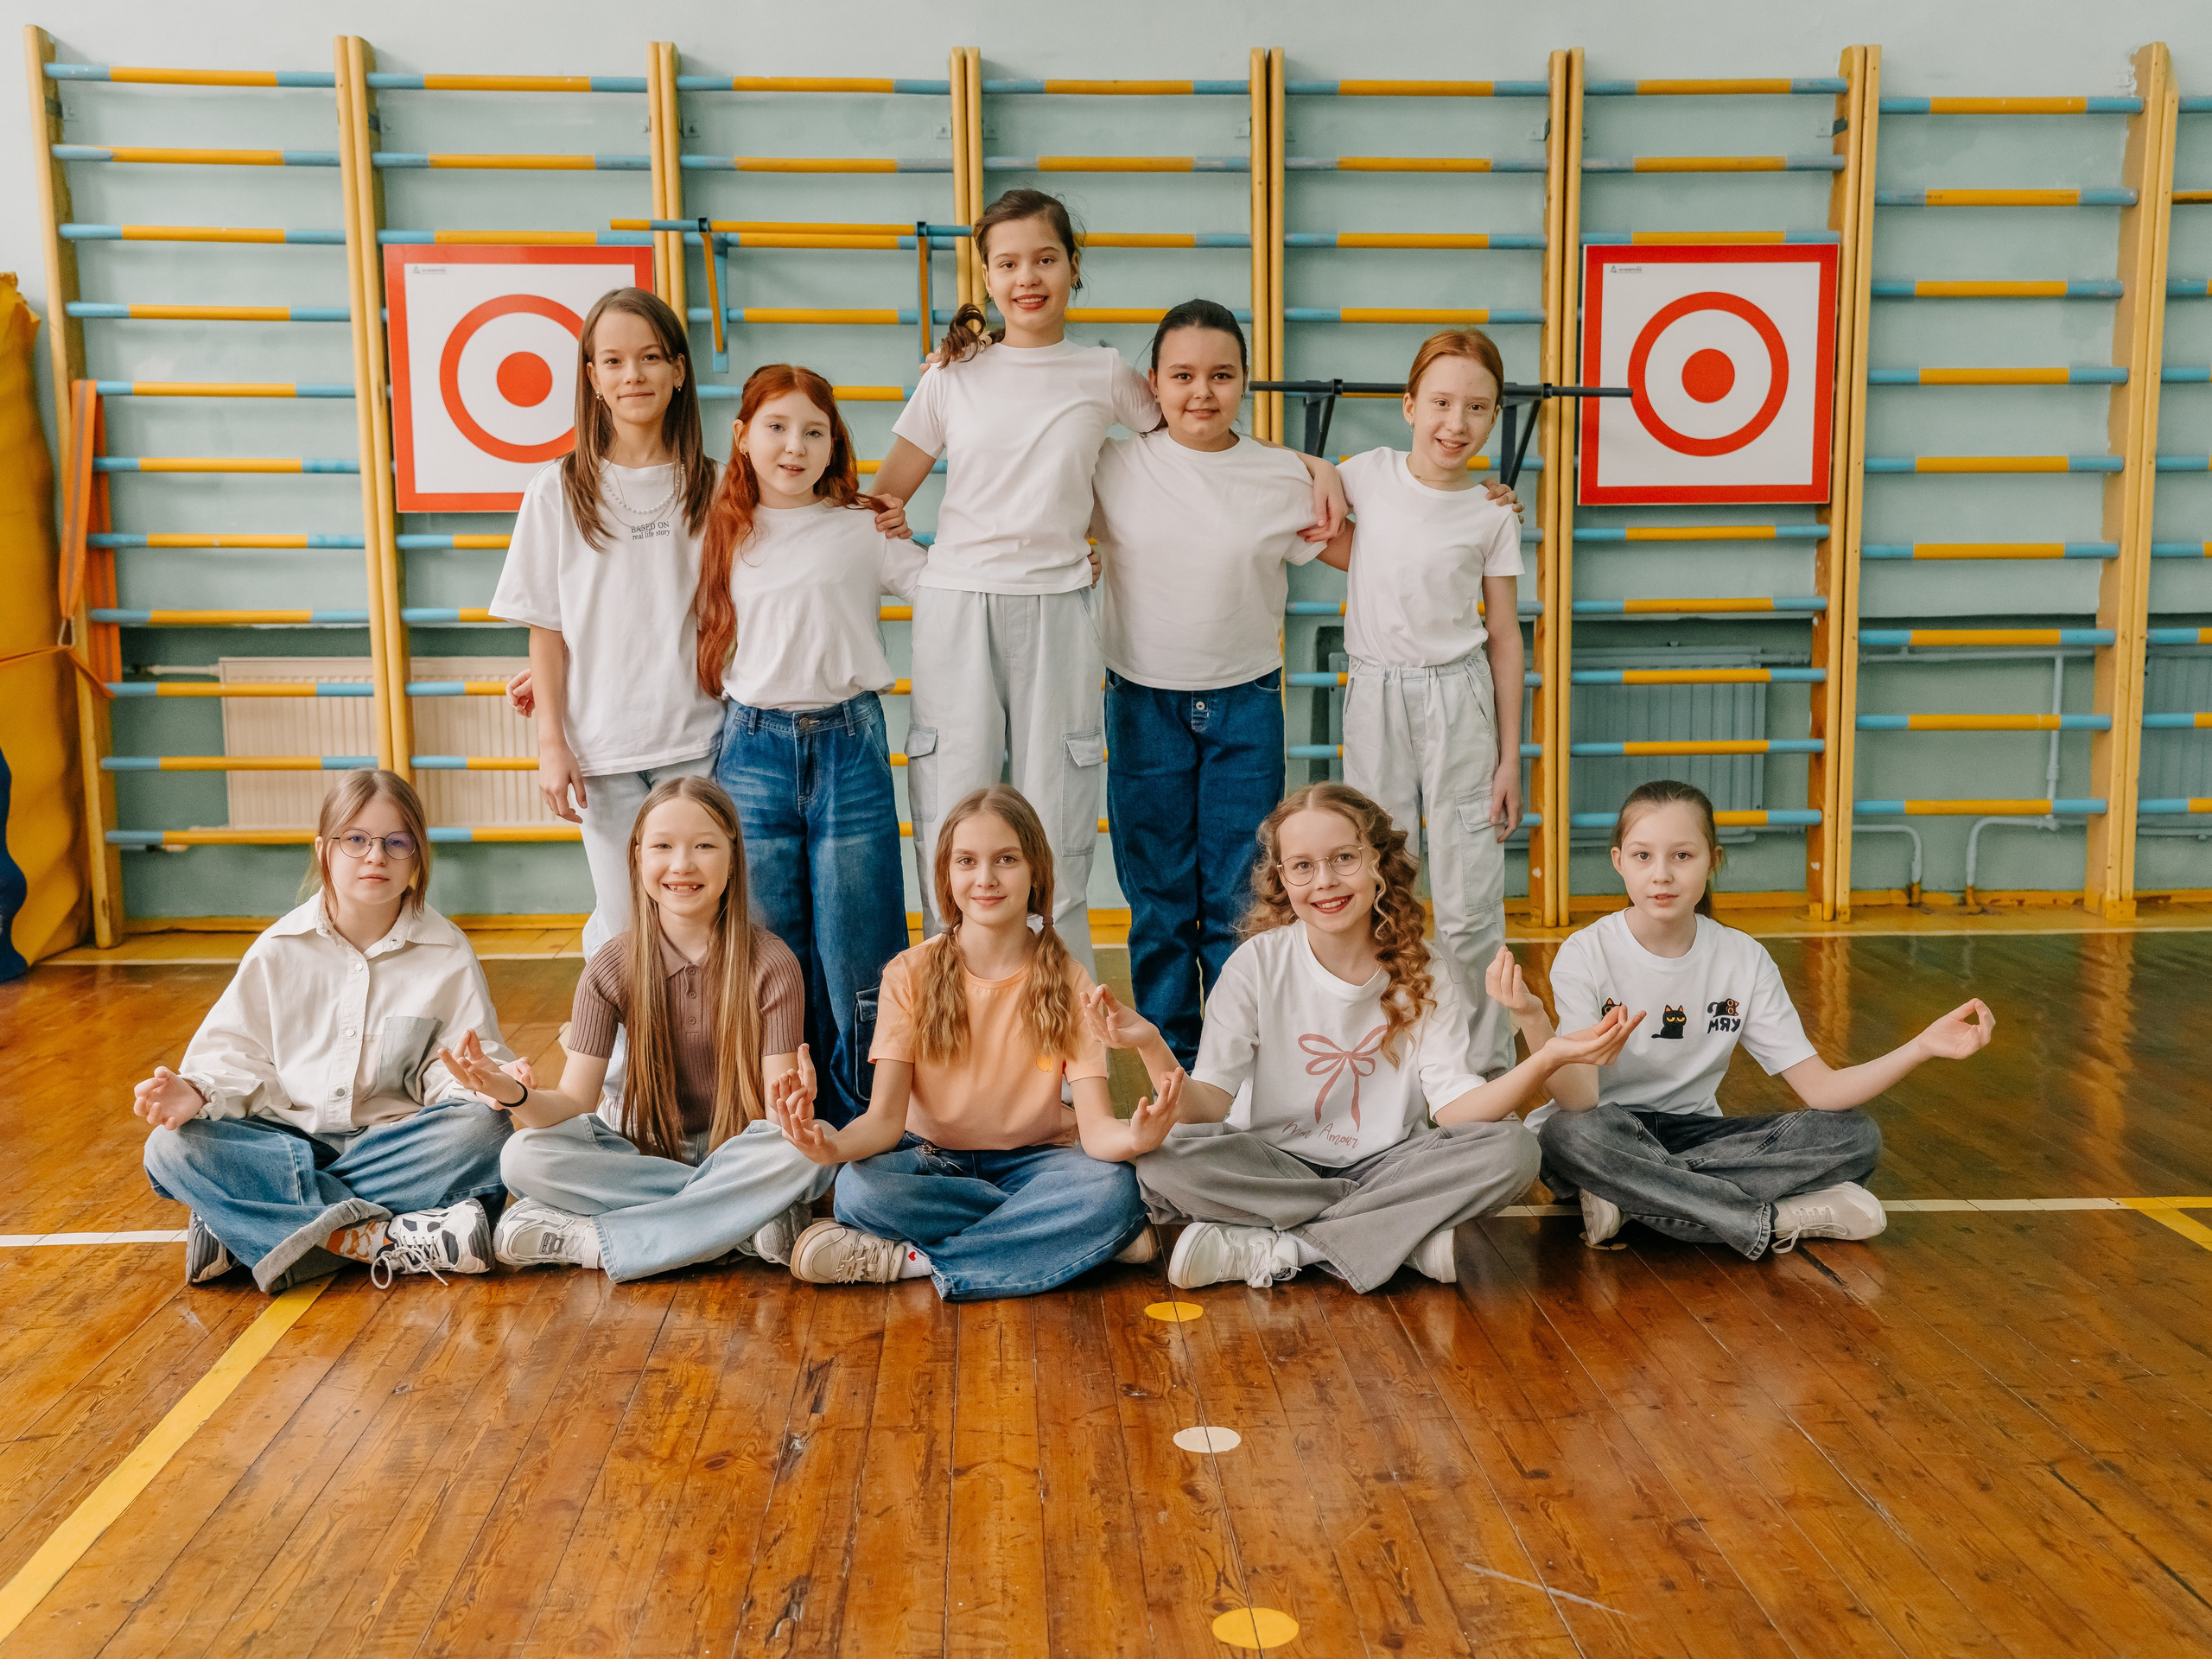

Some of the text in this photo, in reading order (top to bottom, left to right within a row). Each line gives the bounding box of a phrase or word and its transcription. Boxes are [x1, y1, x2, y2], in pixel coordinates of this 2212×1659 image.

[631, 522, 656, 533] BASED
[632, 531, 644, 540] real
[645, 529, 655, 538] life
[1707, 1017, 1742, 1033] МЯУ
[1318, 1123, 1359, 1149] Amour
